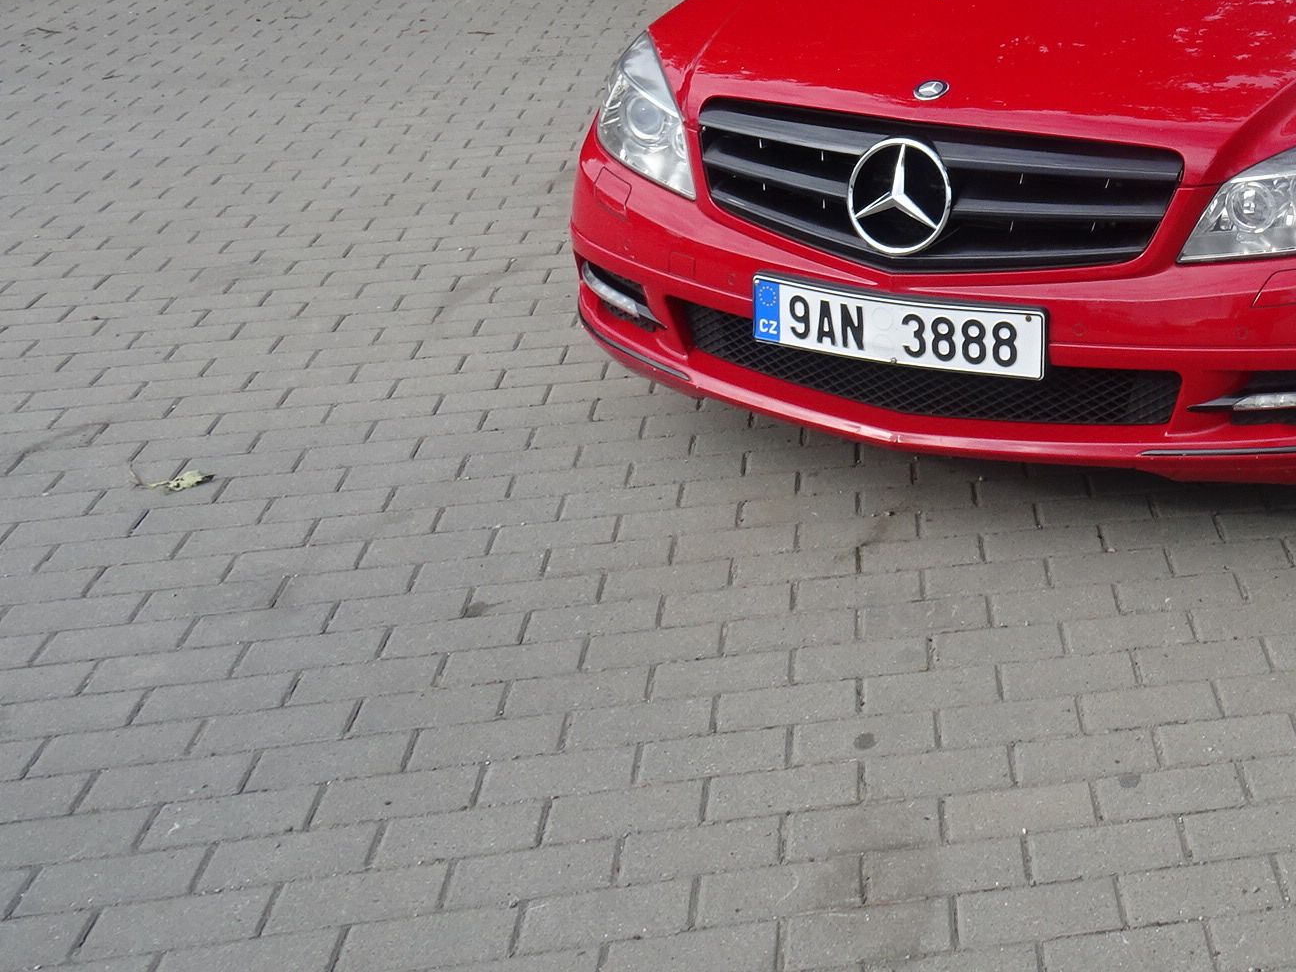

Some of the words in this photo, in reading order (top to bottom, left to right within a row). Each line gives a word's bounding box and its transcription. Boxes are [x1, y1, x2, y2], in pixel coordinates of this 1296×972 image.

[759, 318, 778, 335] CZ
[789, 294, 865, 350] 9AN
[901, 313, 1018, 368] 3888
